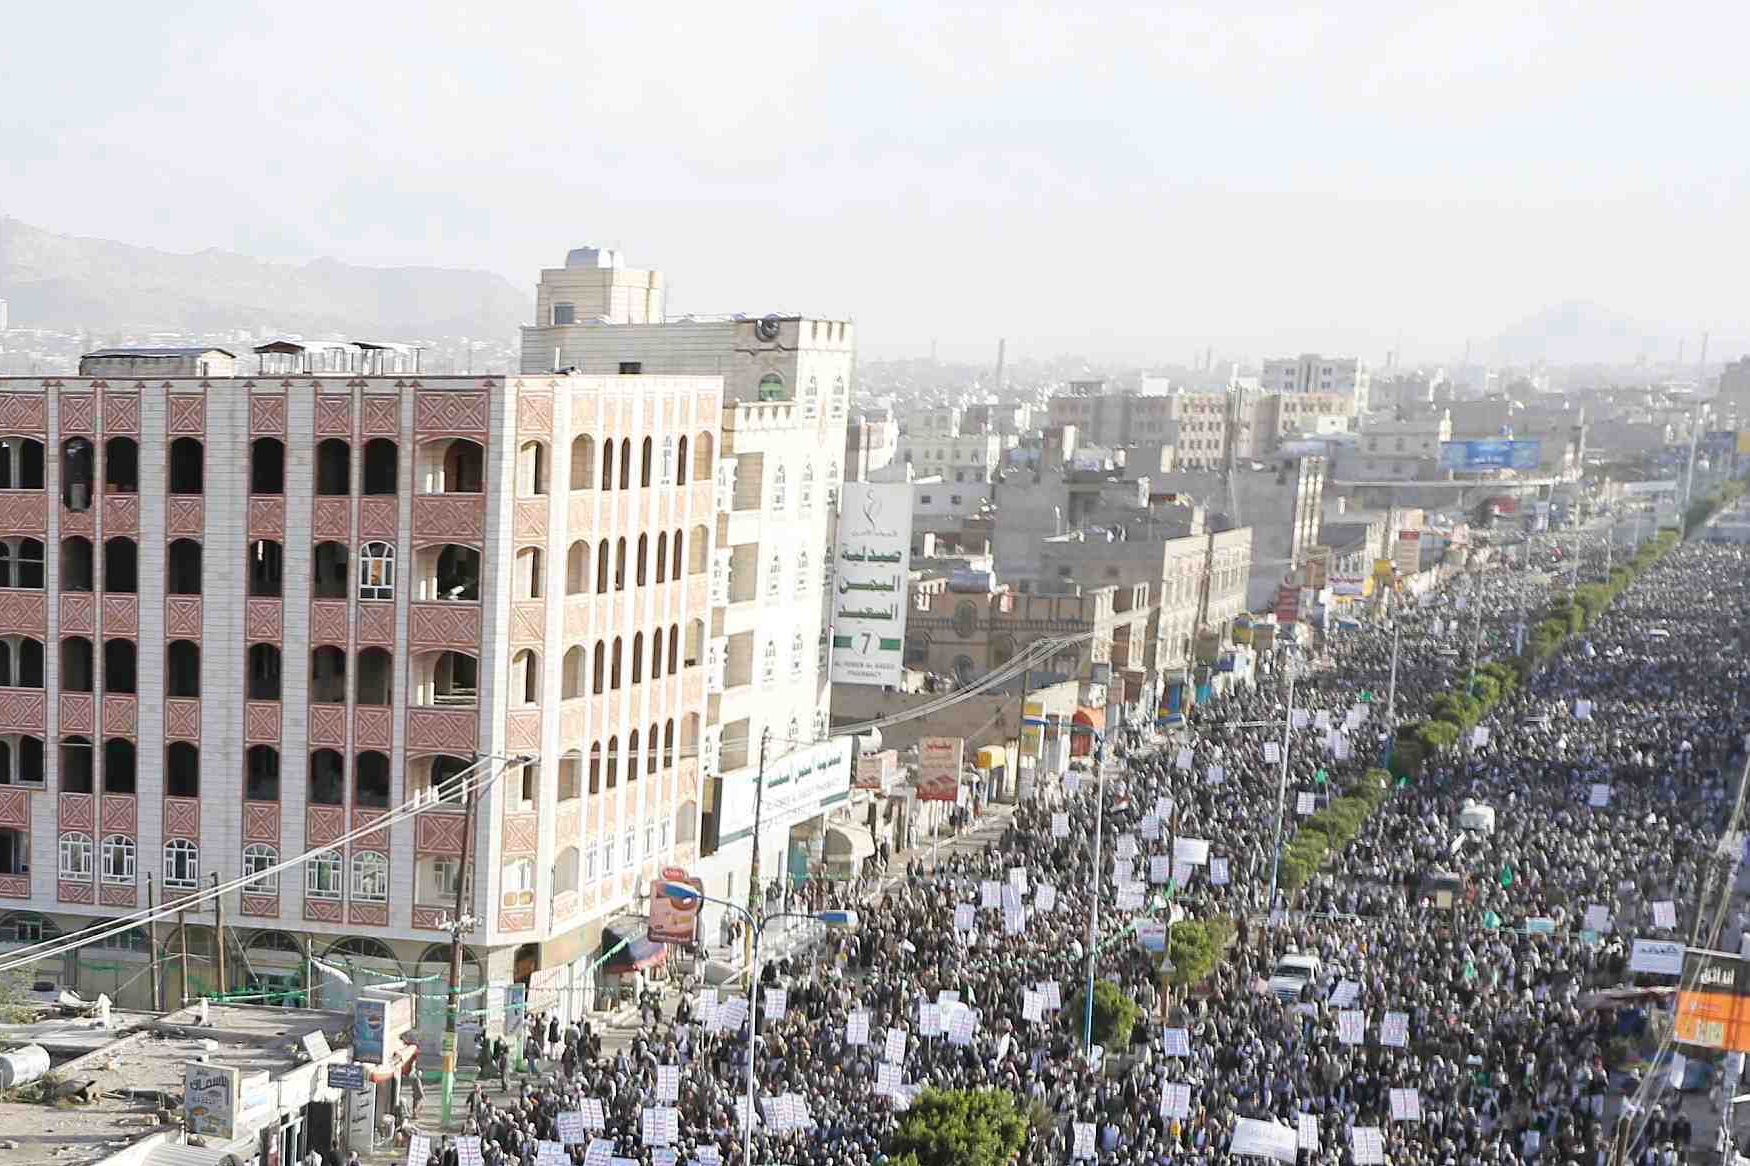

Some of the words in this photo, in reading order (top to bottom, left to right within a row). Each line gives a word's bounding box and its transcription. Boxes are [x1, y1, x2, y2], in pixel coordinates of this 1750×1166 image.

[841, 543, 902, 568] صيدلية
[839, 575, 900, 597] اليمن
[838, 602, 898, 624] السعيد
[861, 632, 871, 655] 7
